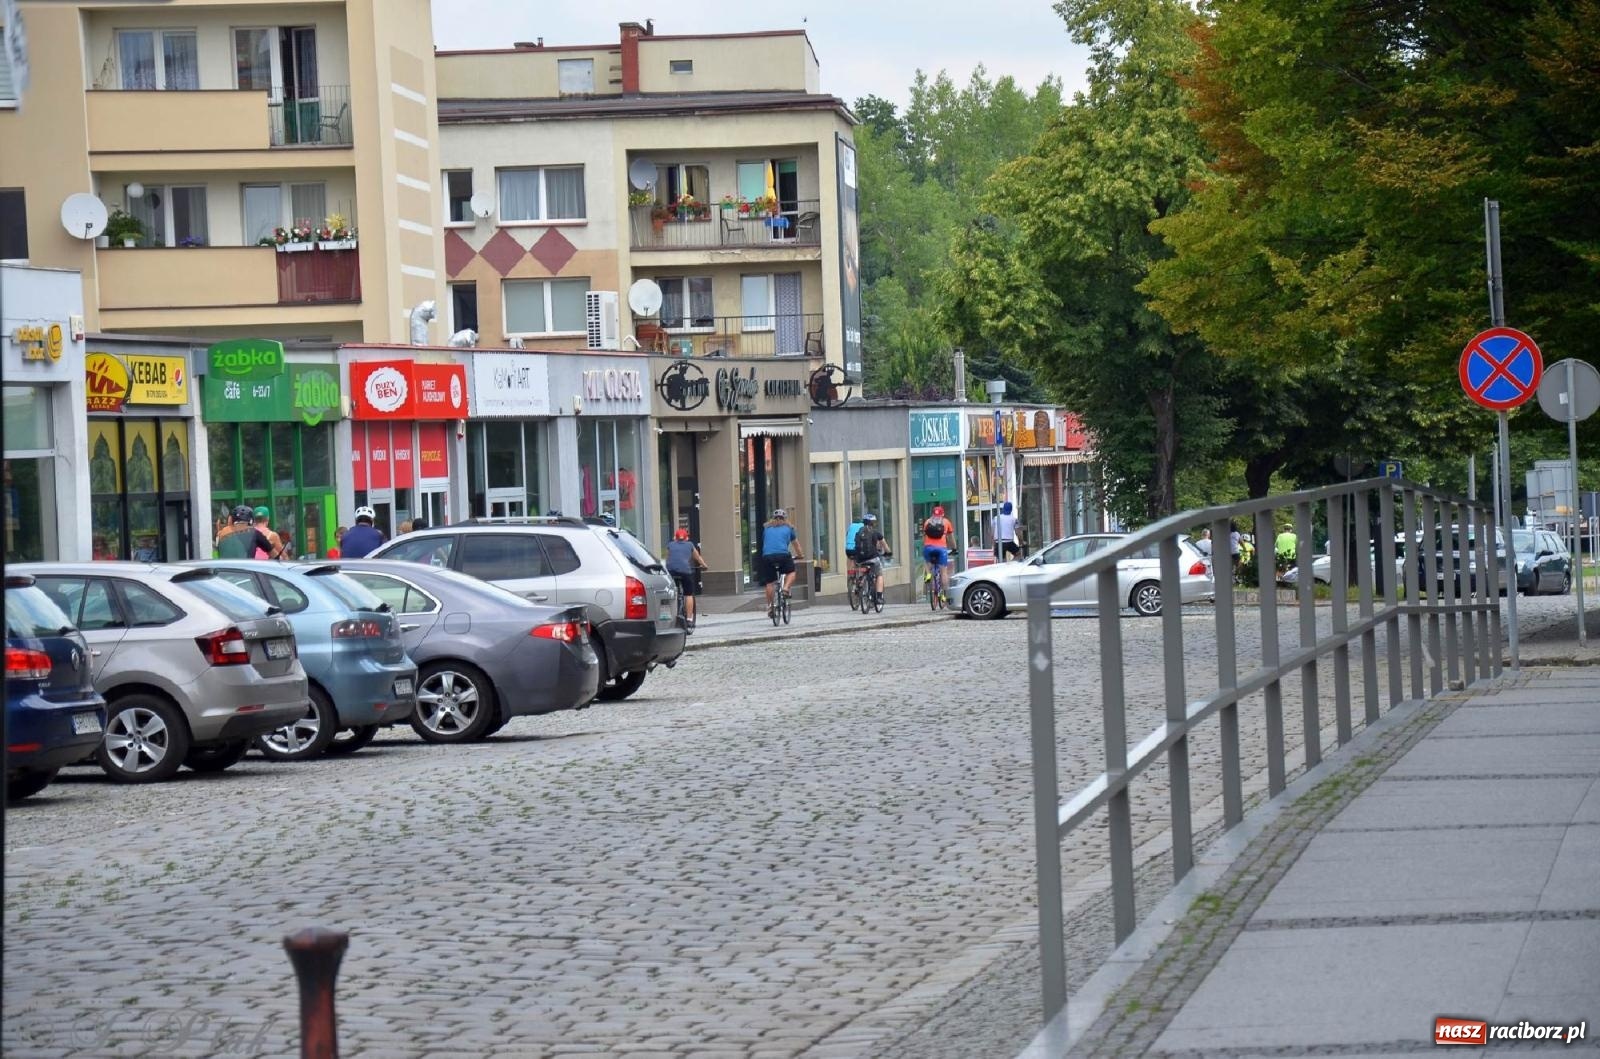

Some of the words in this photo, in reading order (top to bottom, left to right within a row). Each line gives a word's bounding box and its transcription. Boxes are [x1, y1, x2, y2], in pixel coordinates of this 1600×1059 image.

[213, 348, 276, 367] żabka
[130, 361, 167, 384] KEBAB
[293, 373, 339, 408] żabka
[377, 388, 398, 399] BEN
[921, 416, 950, 443] OSKAR
[1385, 463, 1397, 478] P
